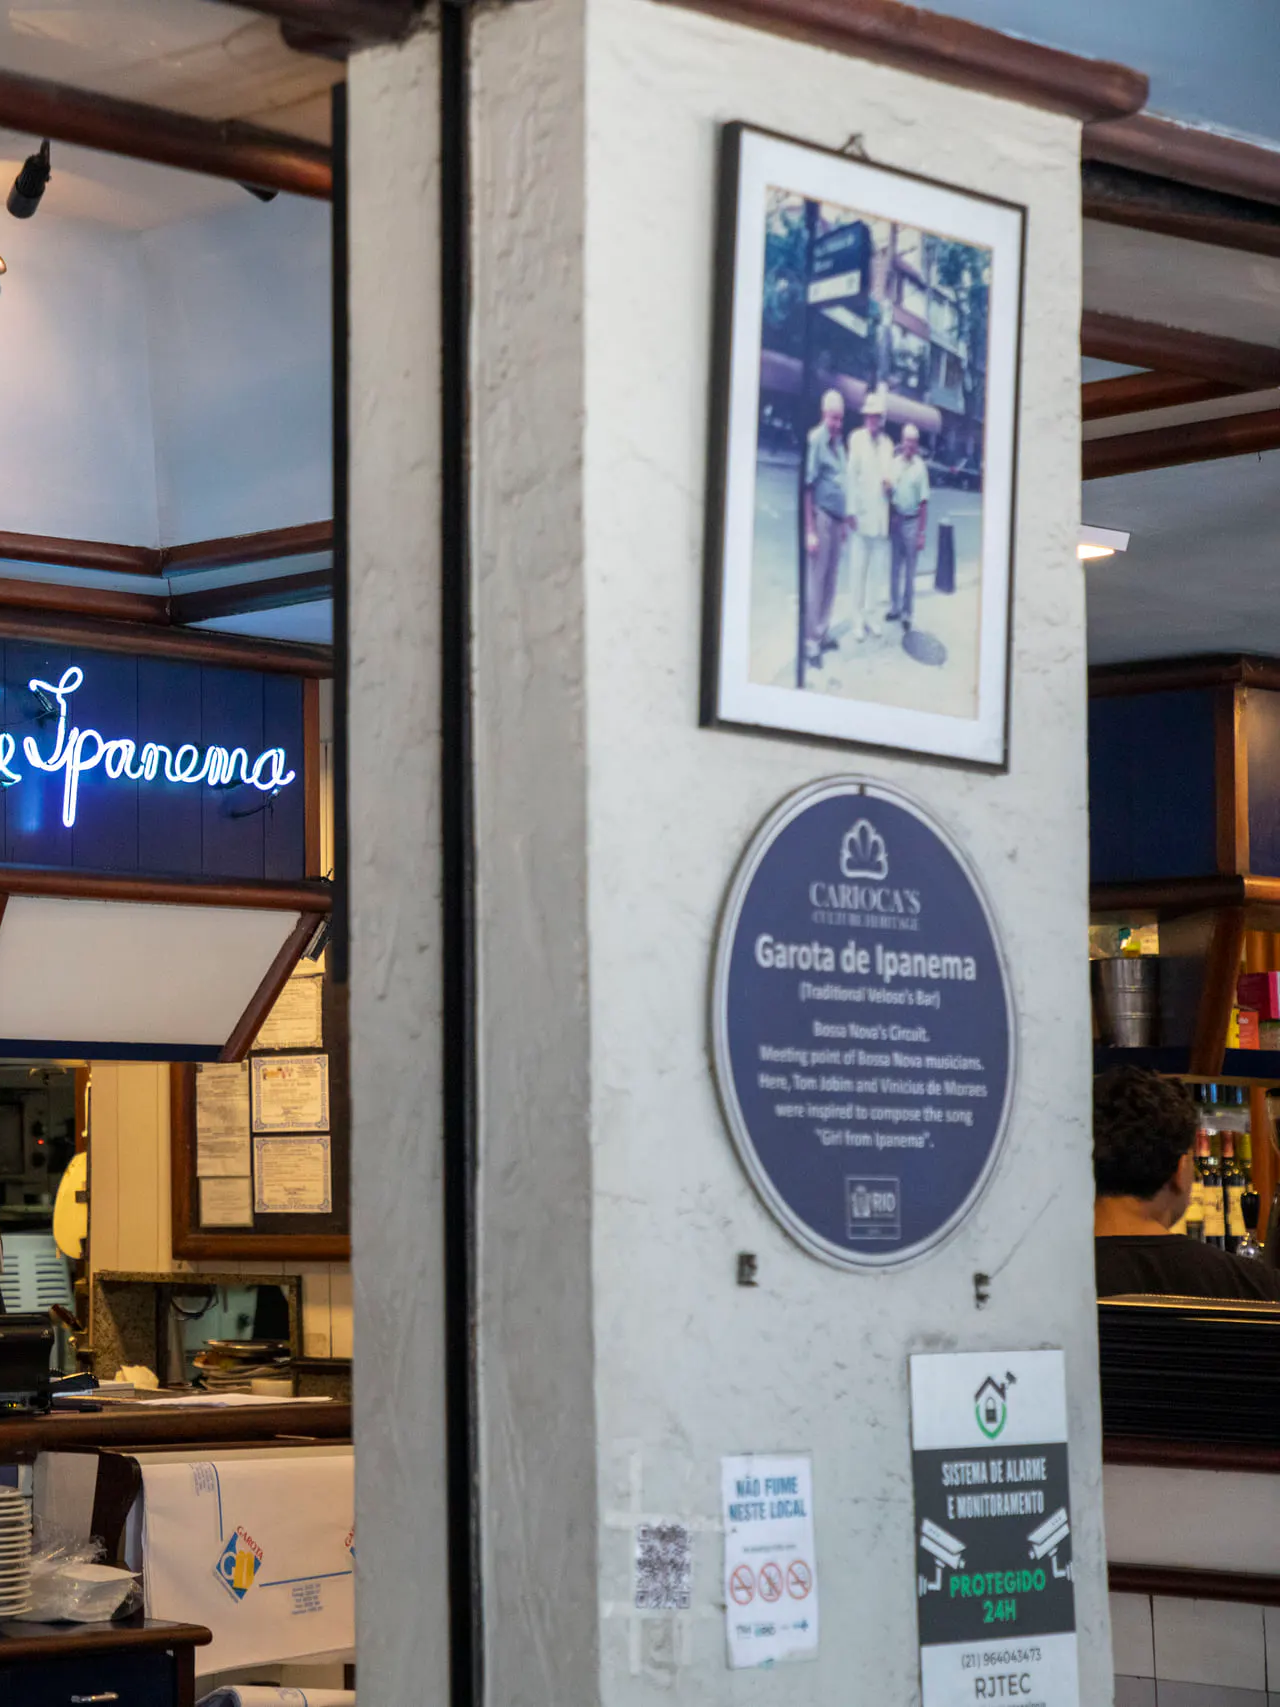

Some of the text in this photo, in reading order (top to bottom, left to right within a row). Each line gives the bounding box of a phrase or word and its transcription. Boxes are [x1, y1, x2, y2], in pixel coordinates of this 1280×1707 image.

[24, 666, 296, 828] Ipanema
[808, 881, 921, 915] CARIOCA'S
[754, 932, 977, 984] Garota de Ipanema
[799, 981, 941, 1010] (Traditional Veloso's Bar)
[812, 1020, 931, 1043] Bossa Nova's Circuit.
[758, 1045, 985, 1071] Meeting point of Bossa Nova musicians.
[757, 1072, 791, 1093] Here,
[793, 1073, 818, 1091] Tom
[820, 1075, 854, 1093] Jobim
[856, 1077, 878, 1093] and
[926, 1078, 942, 1096] de
[943, 1080, 988, 1097] Moraes
[774, 1102, 974, 1126] were inspired to compose the song
[846, 1130, 872, 1147] from
[872, 1192, 896, 1213] RIO
[941, 1457, 1047, 1486] SISTEMA DE ALARME
[735, 1475, 798, 1498] NÃO FUME
[728, 1499, 807, 1522] NESTE LOCAL
[946, 1490, 1044, 1520] E MONITORAMENTO
[236, 1526, 264, 1560] GAROTA
[950, 1568, 1046, 1598] PROTEGIDO
[983, 1600, 1016, 1623] 24H
[961, 1653, 980, 1670] (21)
[975, 1673, 1032, 1699] RJTEC
